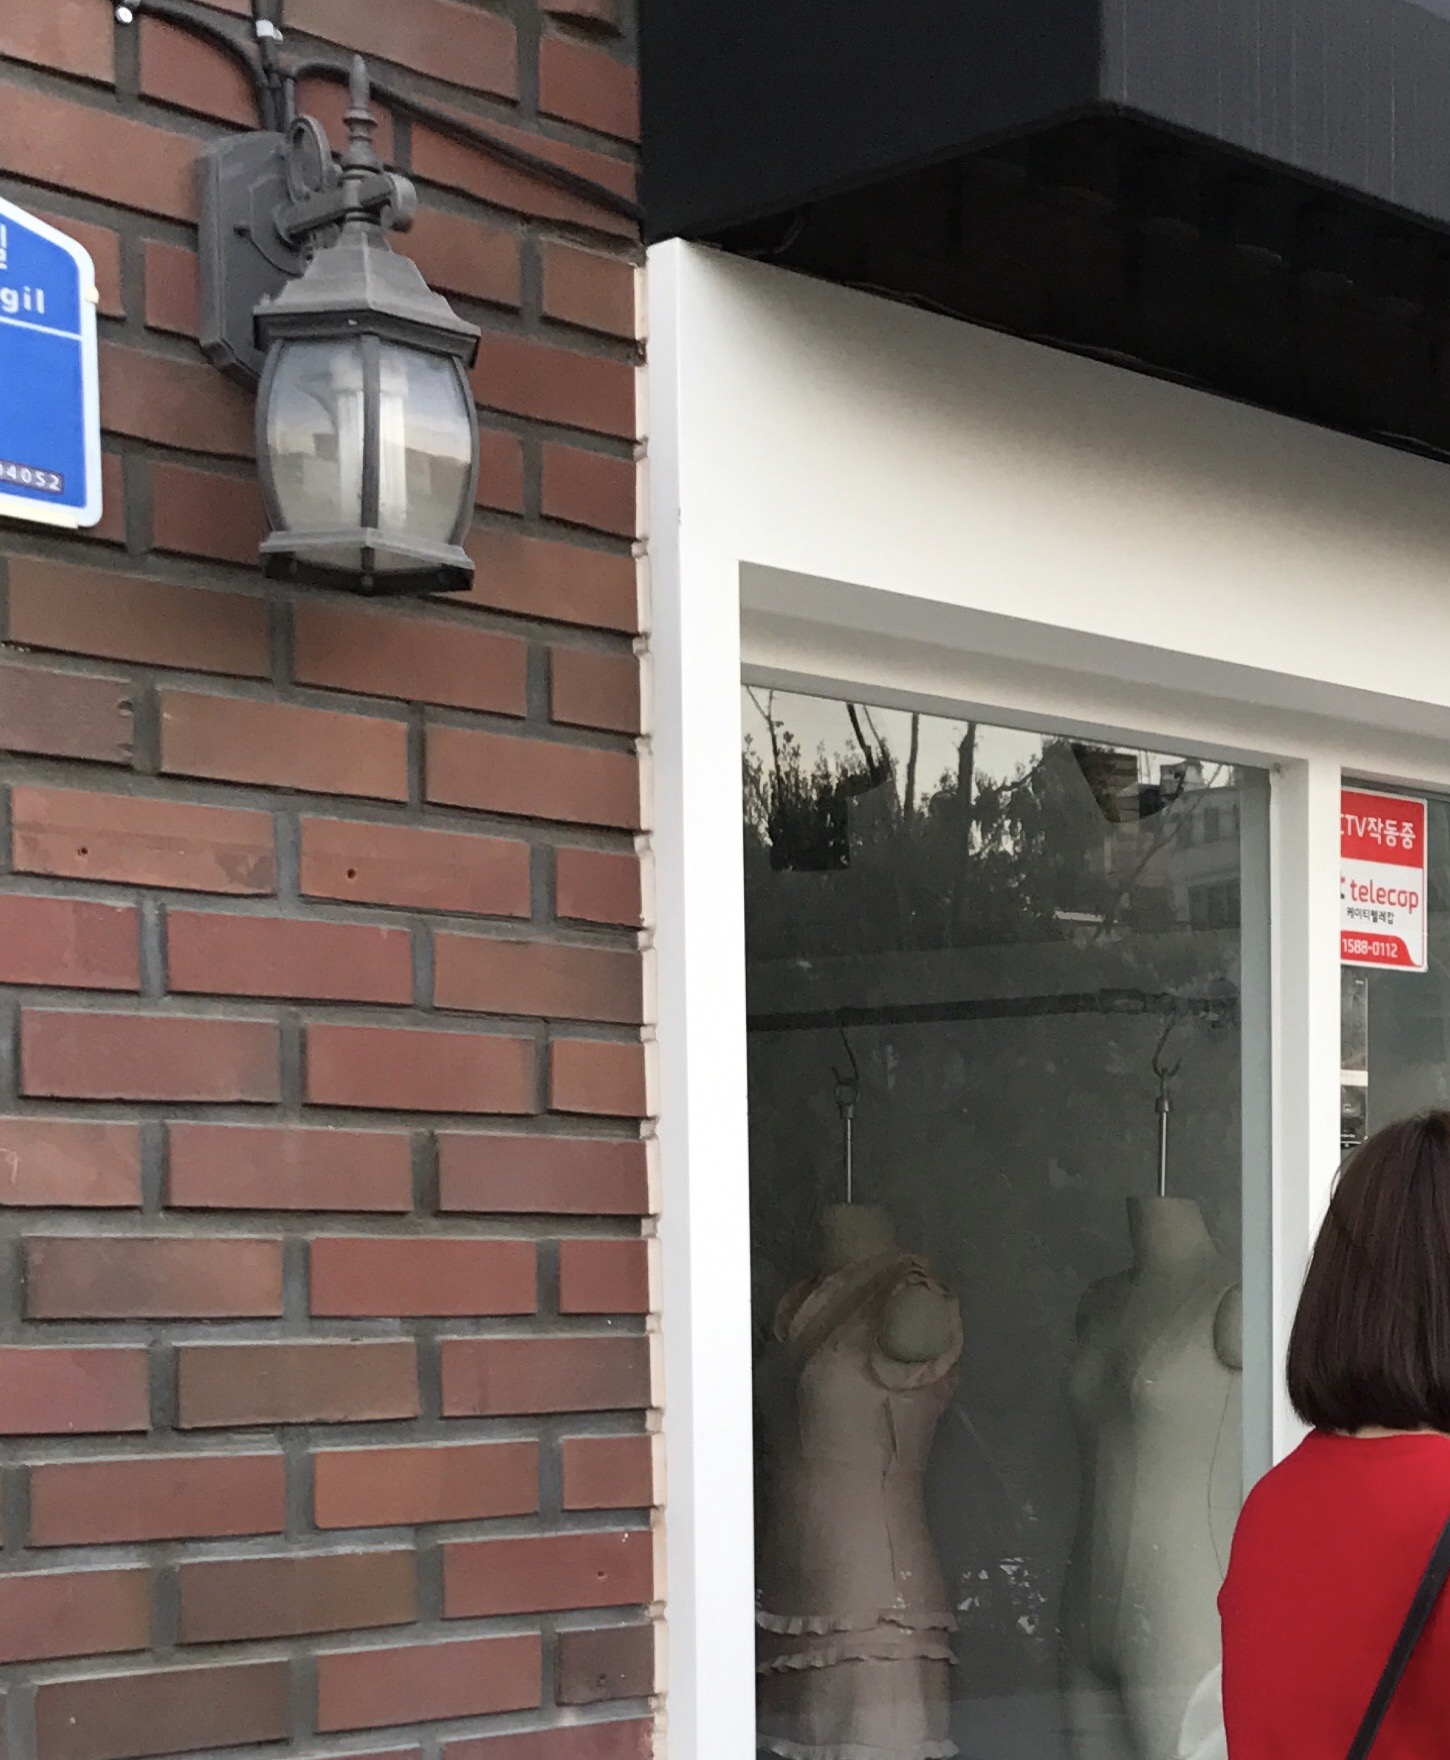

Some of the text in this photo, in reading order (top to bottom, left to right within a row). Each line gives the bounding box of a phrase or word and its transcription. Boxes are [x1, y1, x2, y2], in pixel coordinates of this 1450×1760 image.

[0, 463, 61, 492] 4052
[1341, 813, 1416, 849] TV작동중
[1350, 879, 1419, 914] telecop
[1342, 938, 1398, 958] 1588-0112
